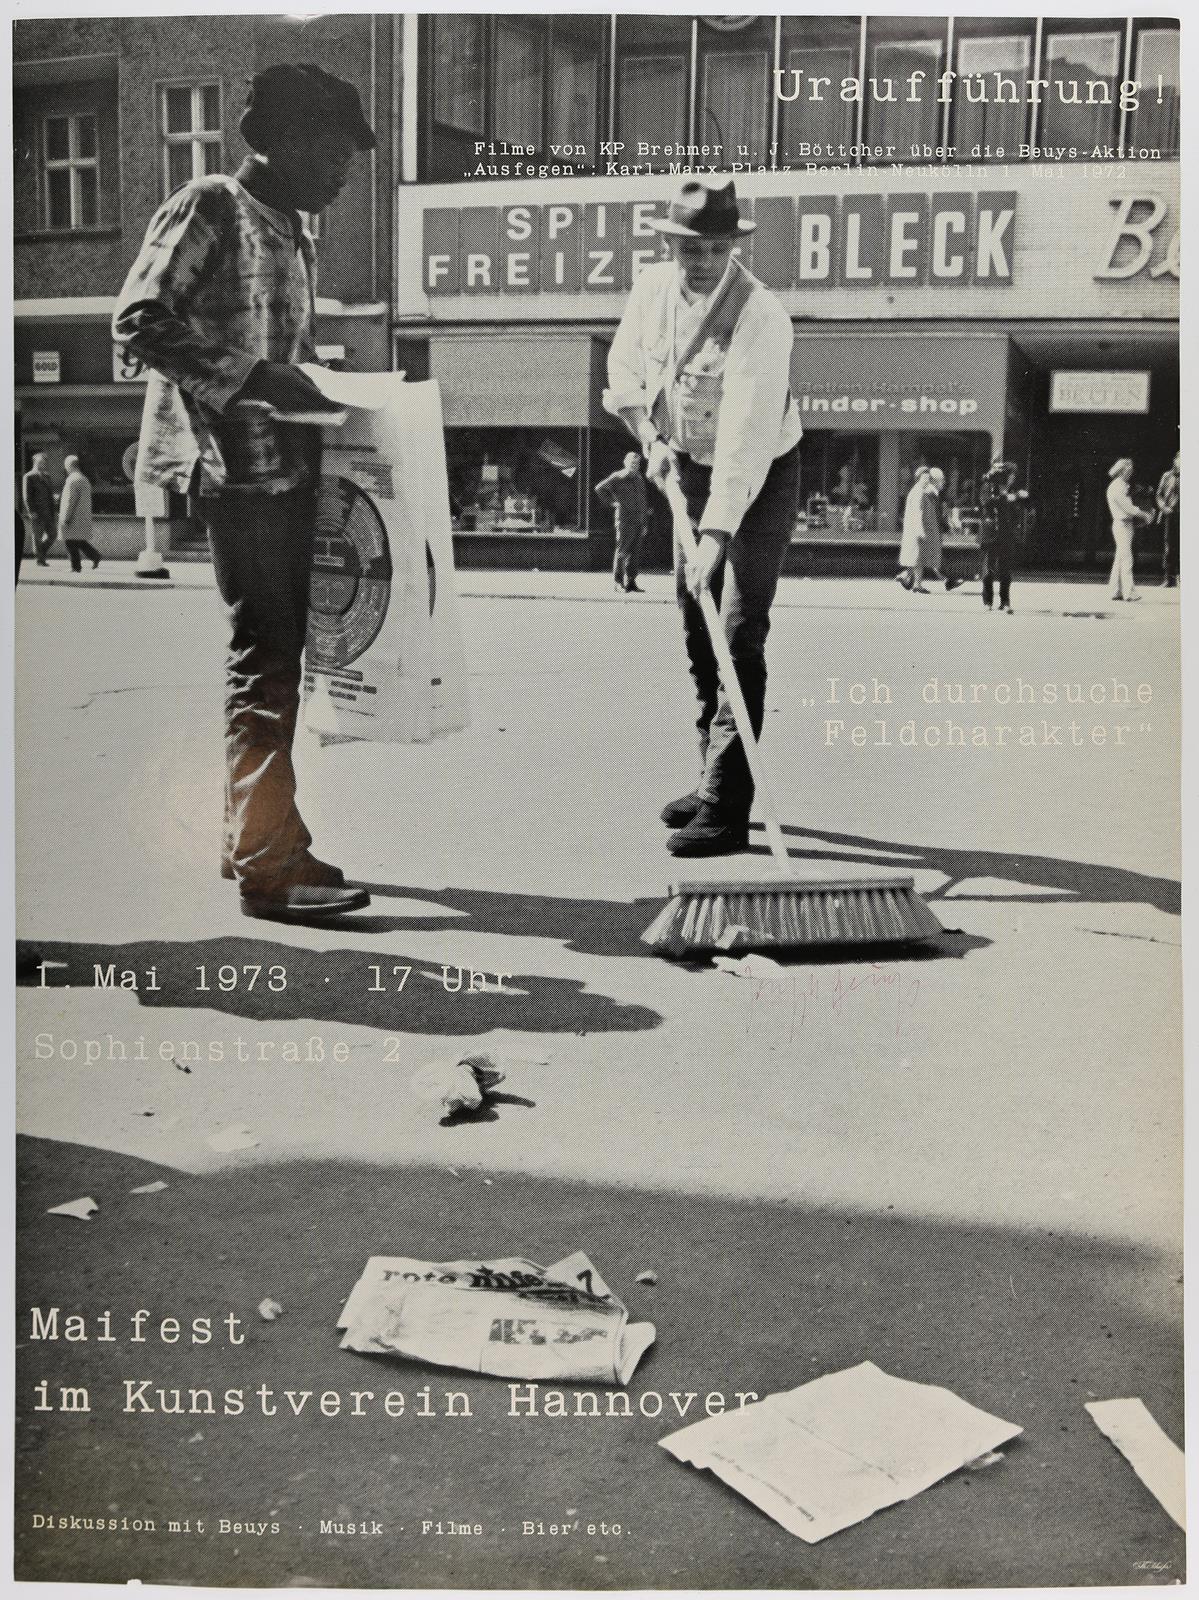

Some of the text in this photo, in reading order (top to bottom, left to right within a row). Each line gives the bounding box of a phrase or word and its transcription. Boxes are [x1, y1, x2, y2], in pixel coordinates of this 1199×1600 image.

[773, 69, 1163, 112] Uraufführung!
[474, 141, 1162, 161] Filme von KP Brehmer u. J. Böttcher über die Beuys-Aktion
[605, 162, 791, 177] Karl-Marx-Platz
[805, 163, 988, 178] Berlin-Neukölln
[1032, 165, 1065, 178] Mai
[1081, 165, 1127, 179] 1972
[800, 210, 1015, 279] BLECK
[922, 678, 1153, 705] durchsuche
[35, 965, 514, 992] 1. Mai 1973 17 Uhr
[34, 1033, 401, 1063] Sophienstraße 2
[30, 1307, 246, 1345] Maifest
[34, 1380, 759, 1418] im Kunstverein Hannover
[32, 1514, 632, 1536] Diskussion mit Beuys Musik Filme Bier etc.
